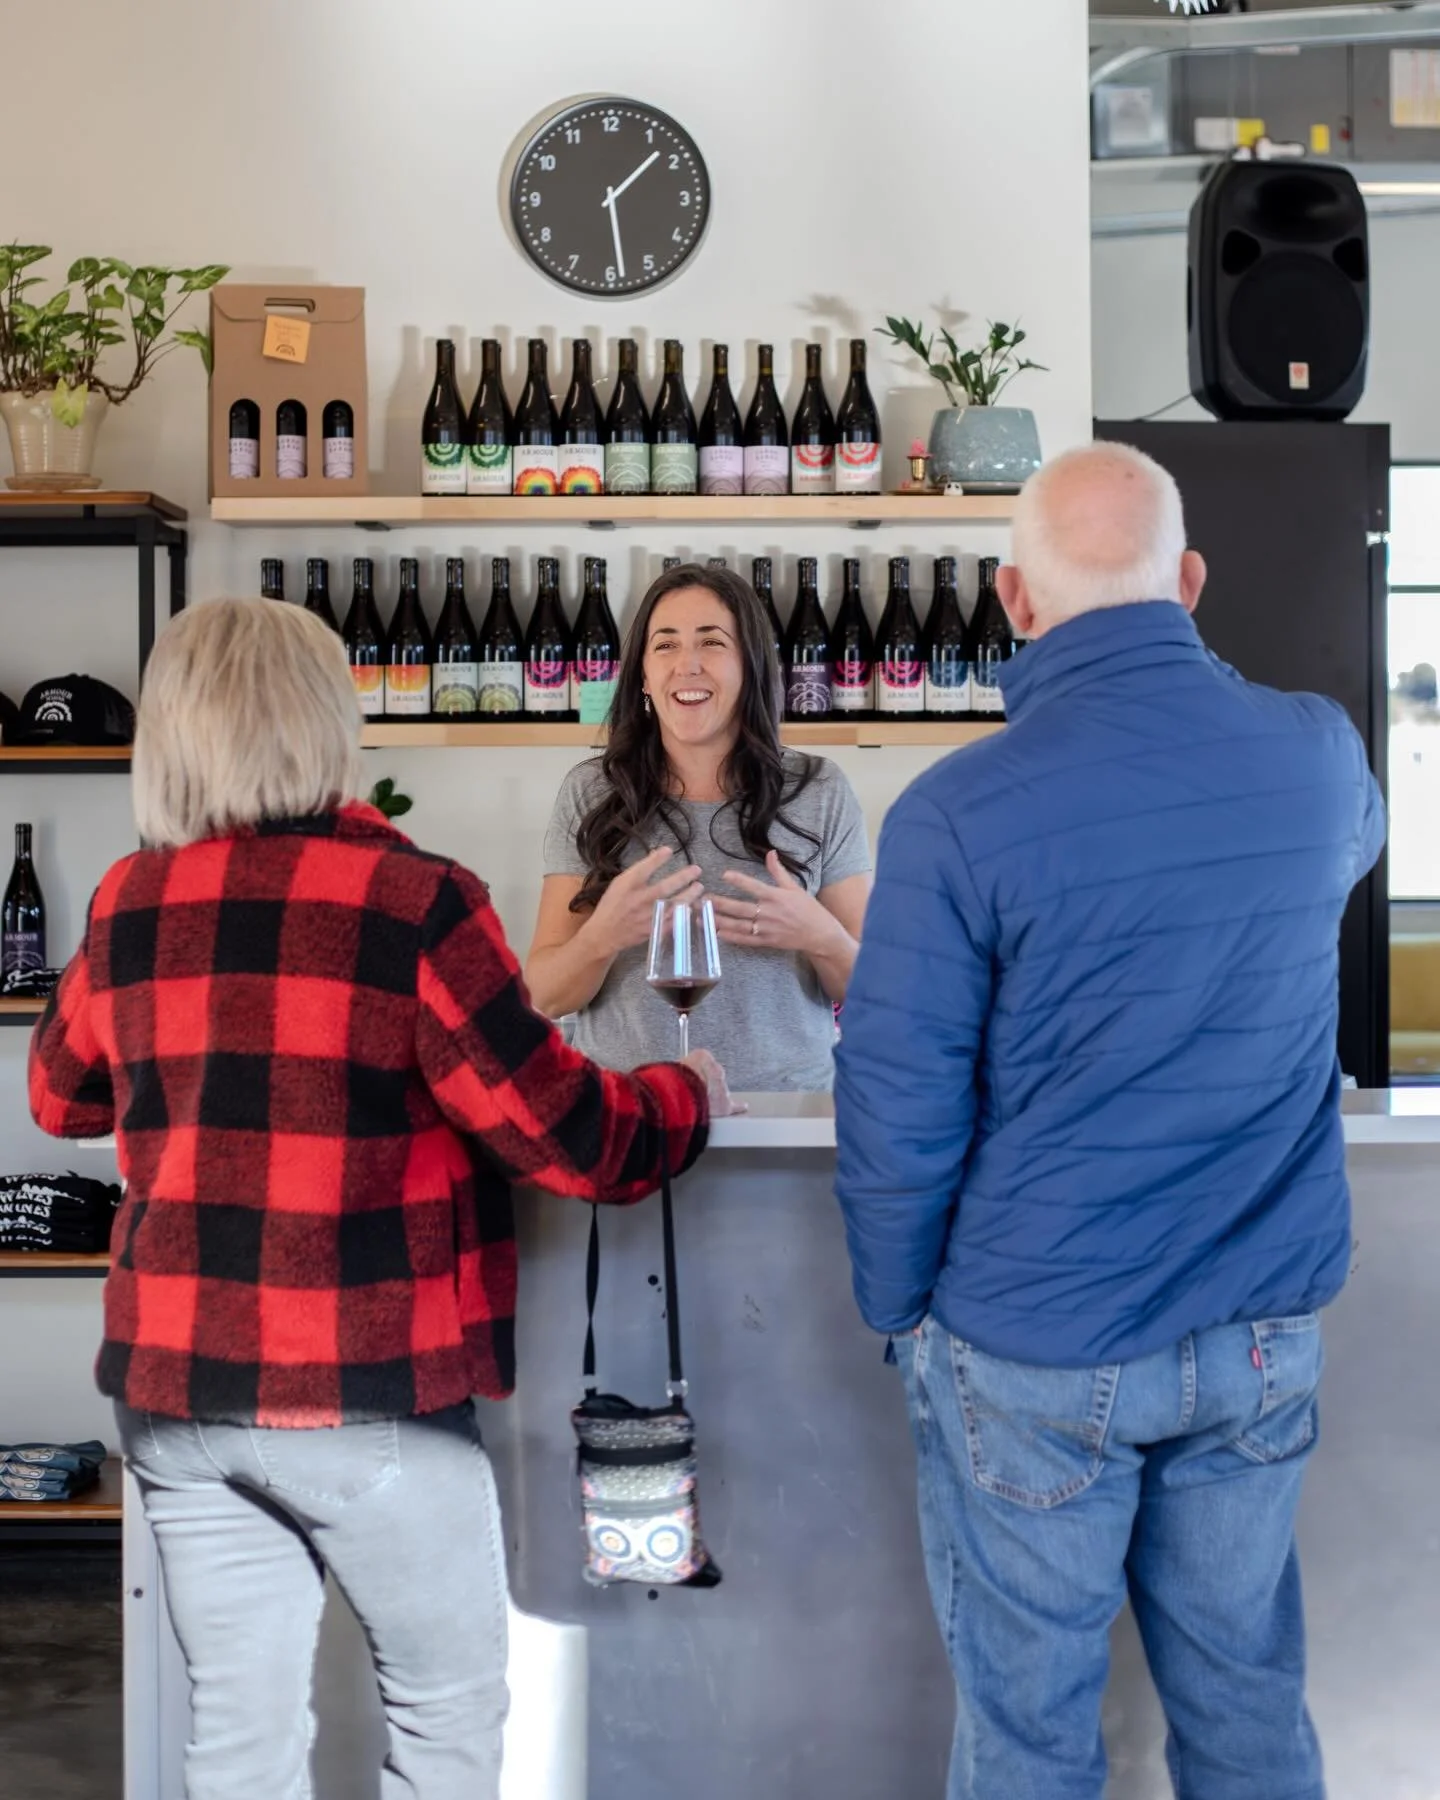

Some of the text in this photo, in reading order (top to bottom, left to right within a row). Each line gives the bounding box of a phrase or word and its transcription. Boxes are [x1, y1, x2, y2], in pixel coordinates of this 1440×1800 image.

[602, 116, 620, 132] 12
[565, 129, 581, 144] 11
[645, 129, 653, 144] 1
[539, 155, 556, 171] 10
[668, 154, 680, 170] 2
[529, 192, 541, 207] 9
[679, 191, 691, 206] 3
[540, 227, 552, 242] 8
[672, 227, 683, 242] 4
[568, 255, 580, 270] 7
[643, 255, 654, 270] 5
[605, 266, 617, 281] 6
[40, 688, 73, 701] ARMOUR
